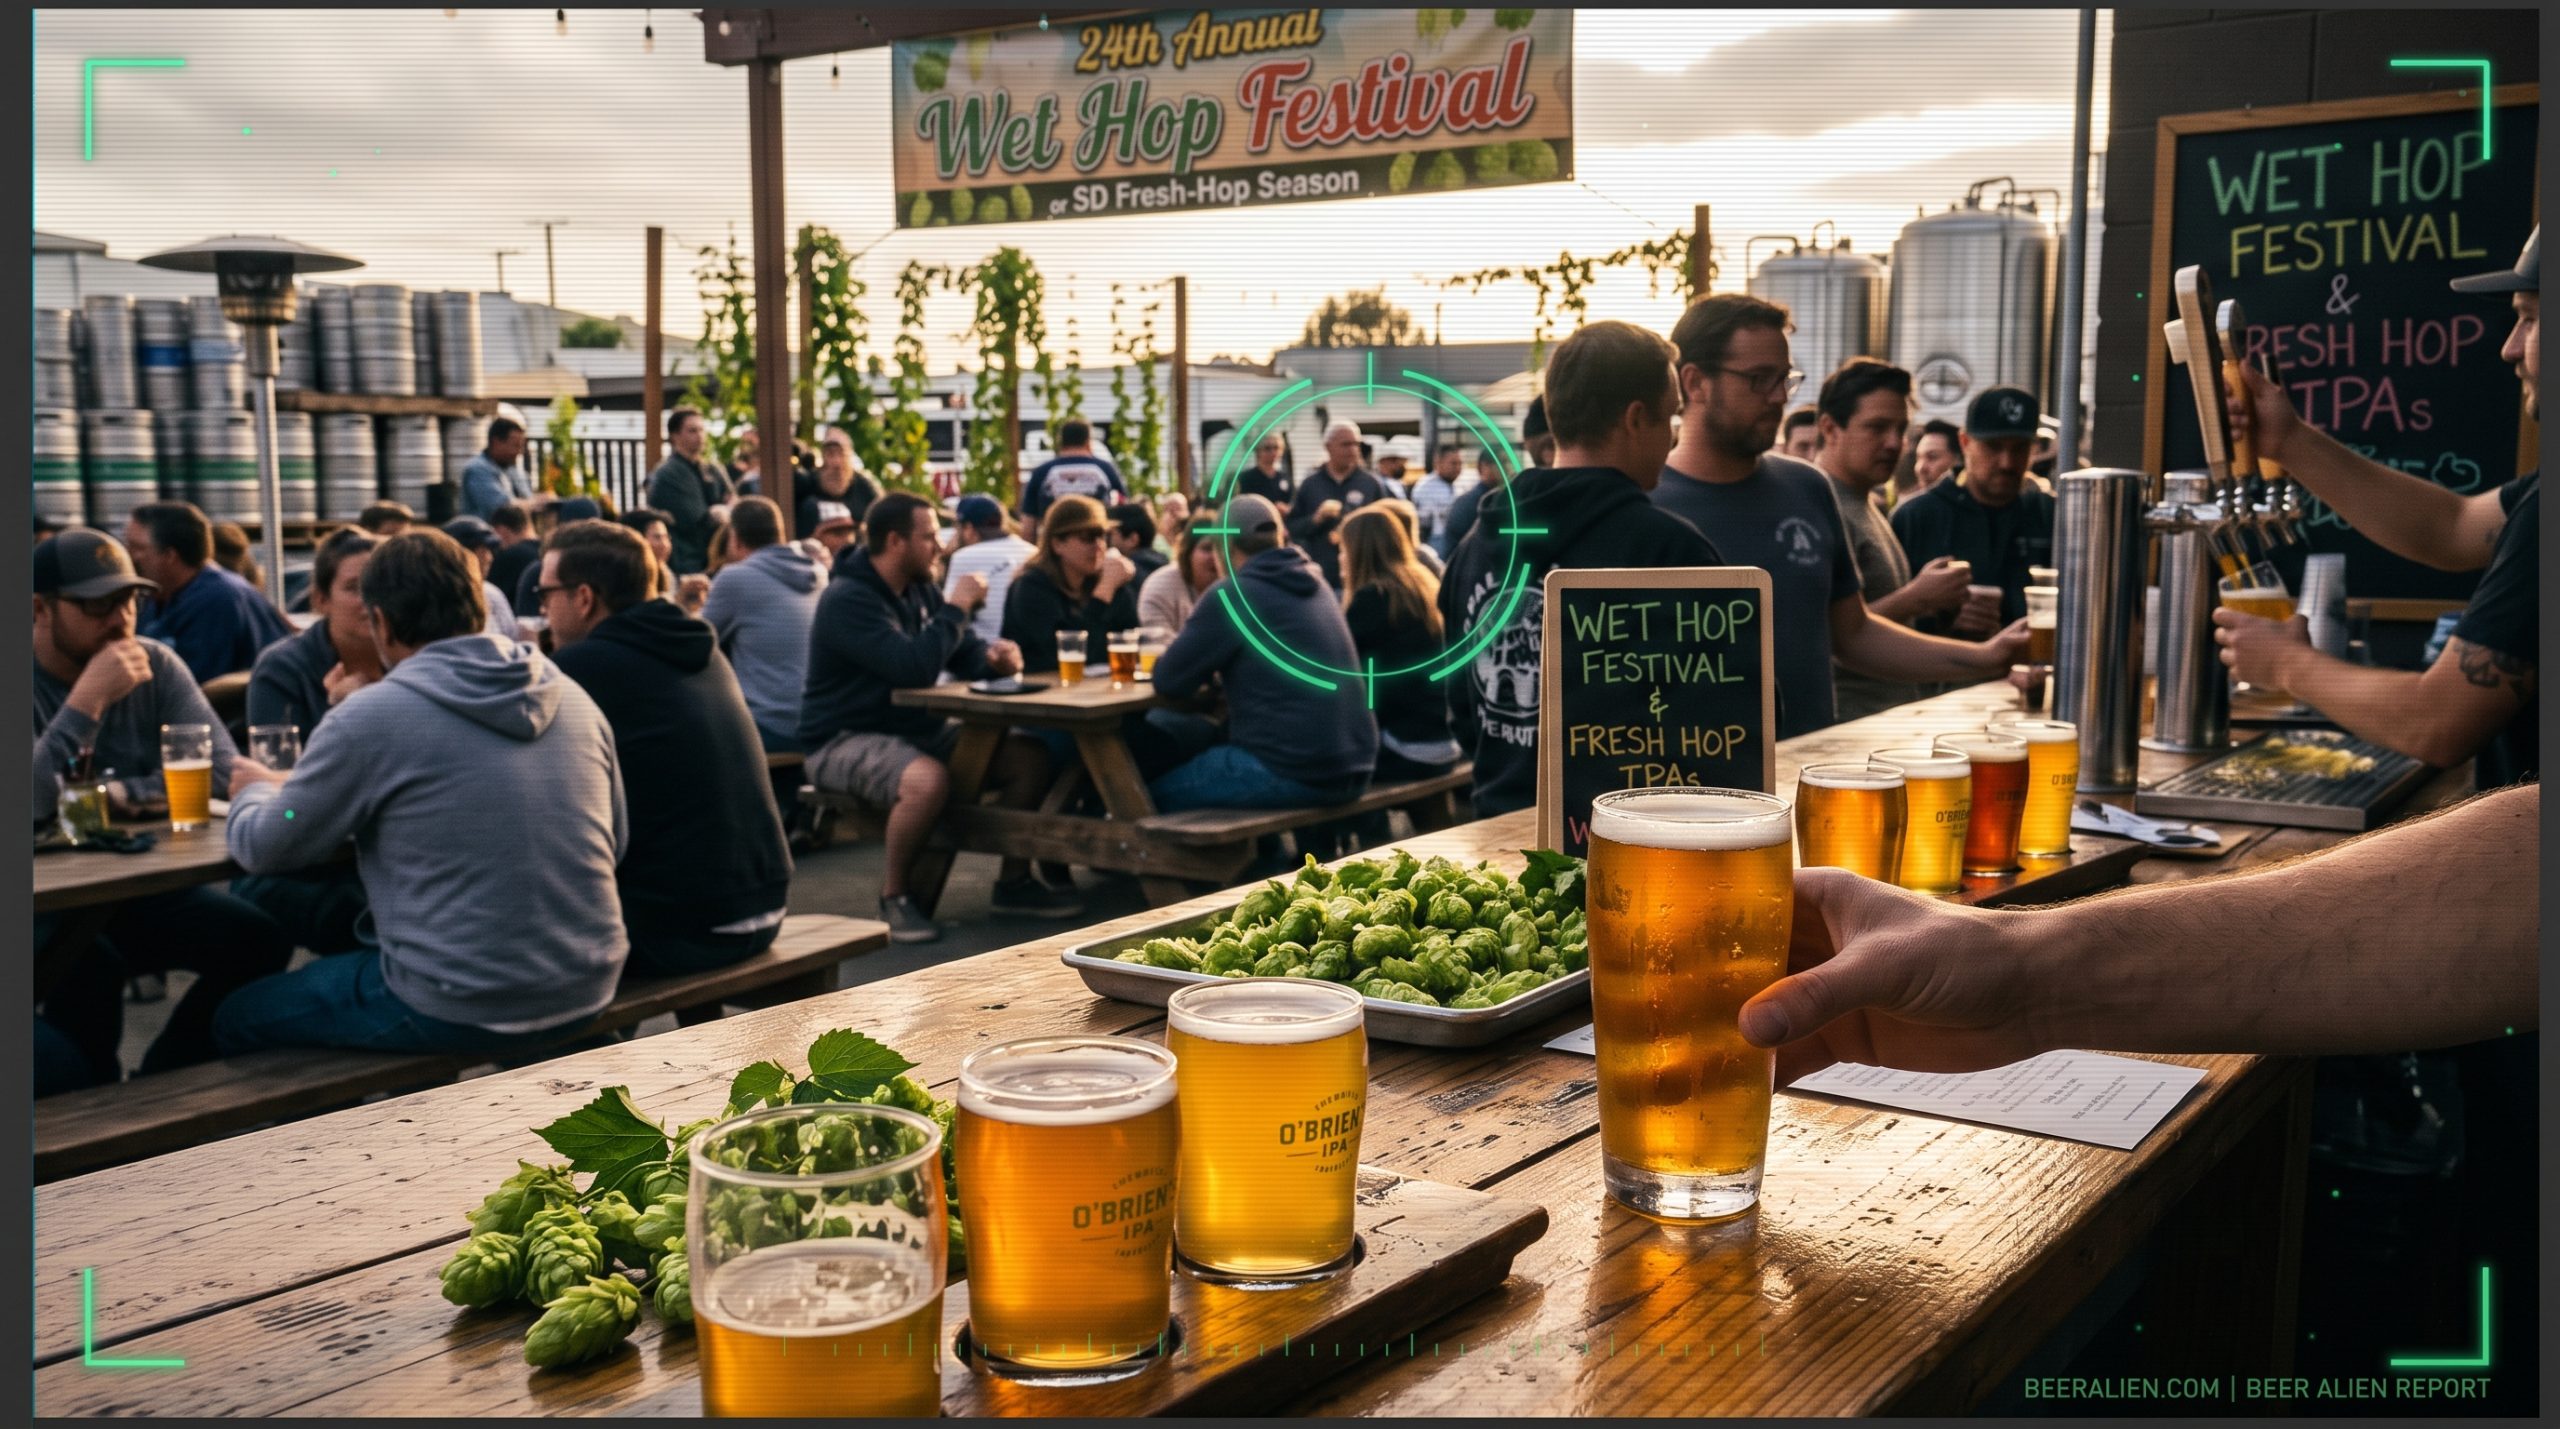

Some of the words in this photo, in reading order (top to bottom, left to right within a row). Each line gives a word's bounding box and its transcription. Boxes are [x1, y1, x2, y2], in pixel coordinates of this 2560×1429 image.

[1075, 22, 1163, 72] 24th
[1173, 9, 1323, 69] Annual
[917, 88, 1062, 178] Wet
[1073, 77, 1222, 174] Hop
[1238, 36, 1536, 152] Festival
[1072, 184, 1108, 211] SD
[1116, 176, 1249, 207] Fresh-Hop
[1257, 169, 1360, 199] Season
[2208, 147, 2342, 216] WET
[2371, 131, 2488, 206] HOP
[2231, 212, 2487, 278] FESTIVAL
[2325, 273, 2360, 315] &
[2245, 321, 2355, 369] RESH
[2381, 315, 2484, 367] HOP
[2291, 376, 2434, 432] IPAs
[1568, 601, 1661, 643] WET
[1676, 600, 1754, 644] HOP
[1583, 650, 1744, 684] FESTIVAL
[1569, 724, 1665, 757] FRESH
[1681, 724, 1746, 760] HOP
[1321, 1138, 1348, 1158] IPA
[1123, 1219, 1153, 1240] IPA
